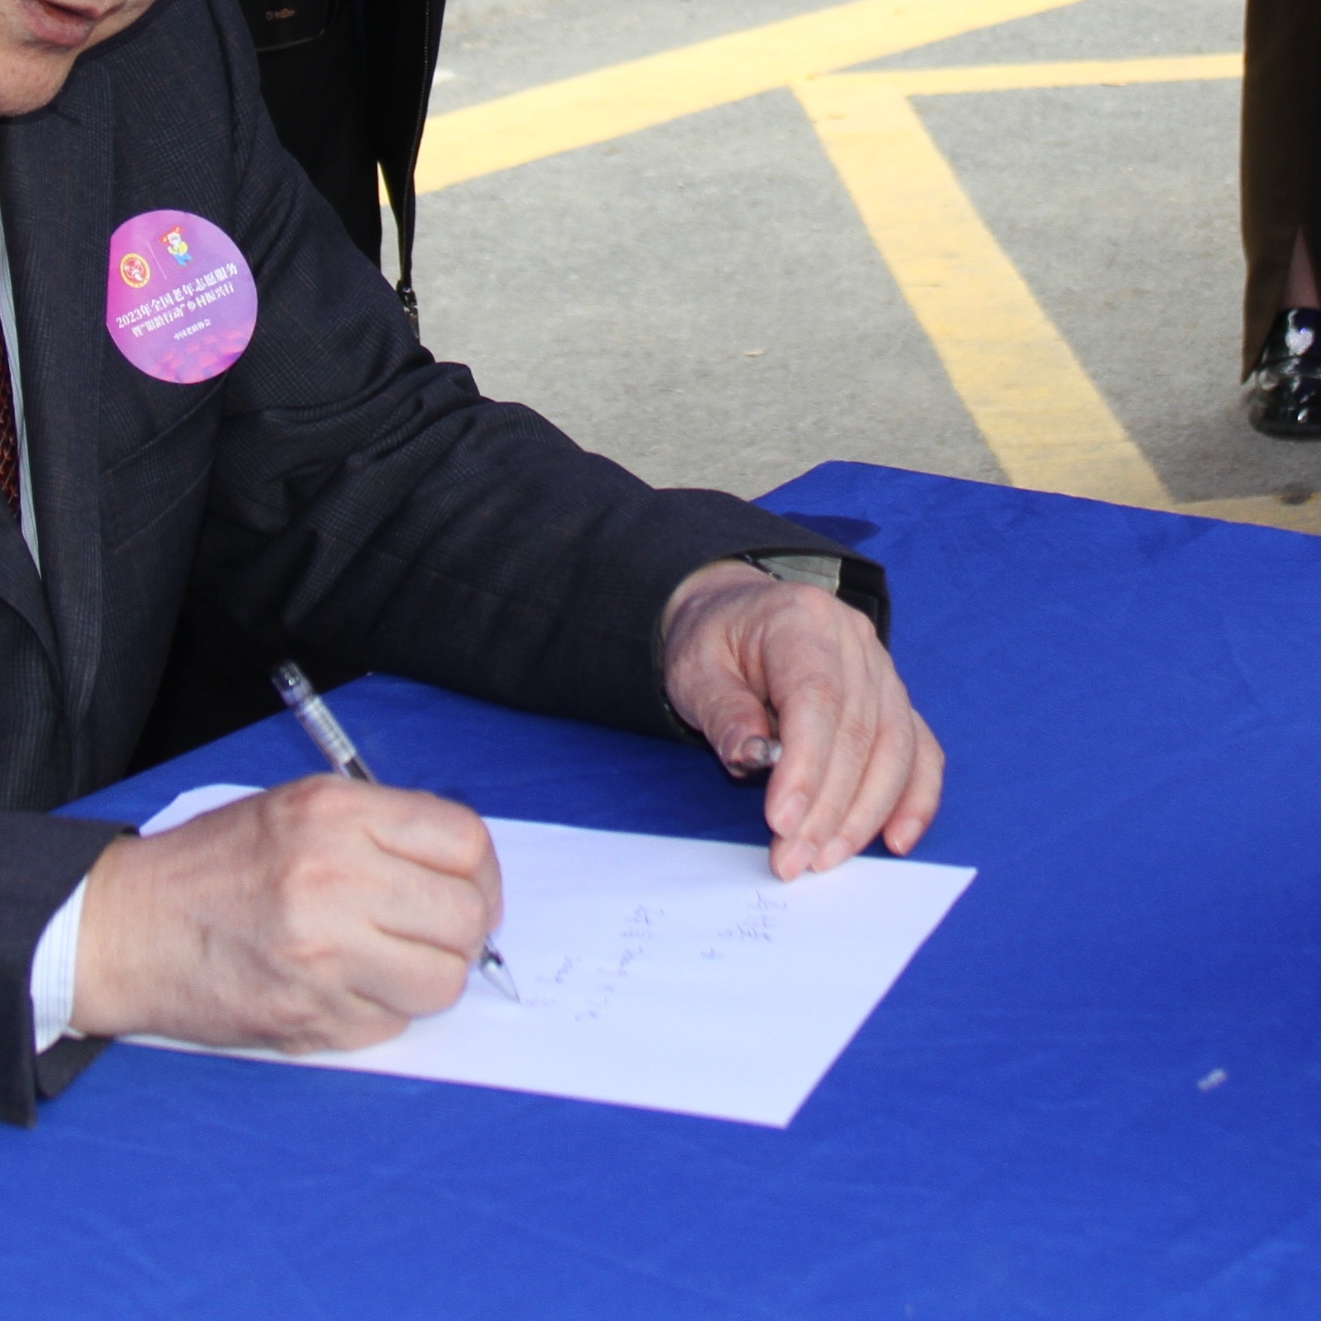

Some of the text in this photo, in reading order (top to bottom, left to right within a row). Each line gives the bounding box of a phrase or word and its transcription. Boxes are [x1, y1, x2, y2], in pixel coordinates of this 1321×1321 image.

[115, 262, 238, 329] 2023年全国老年志愿服务
